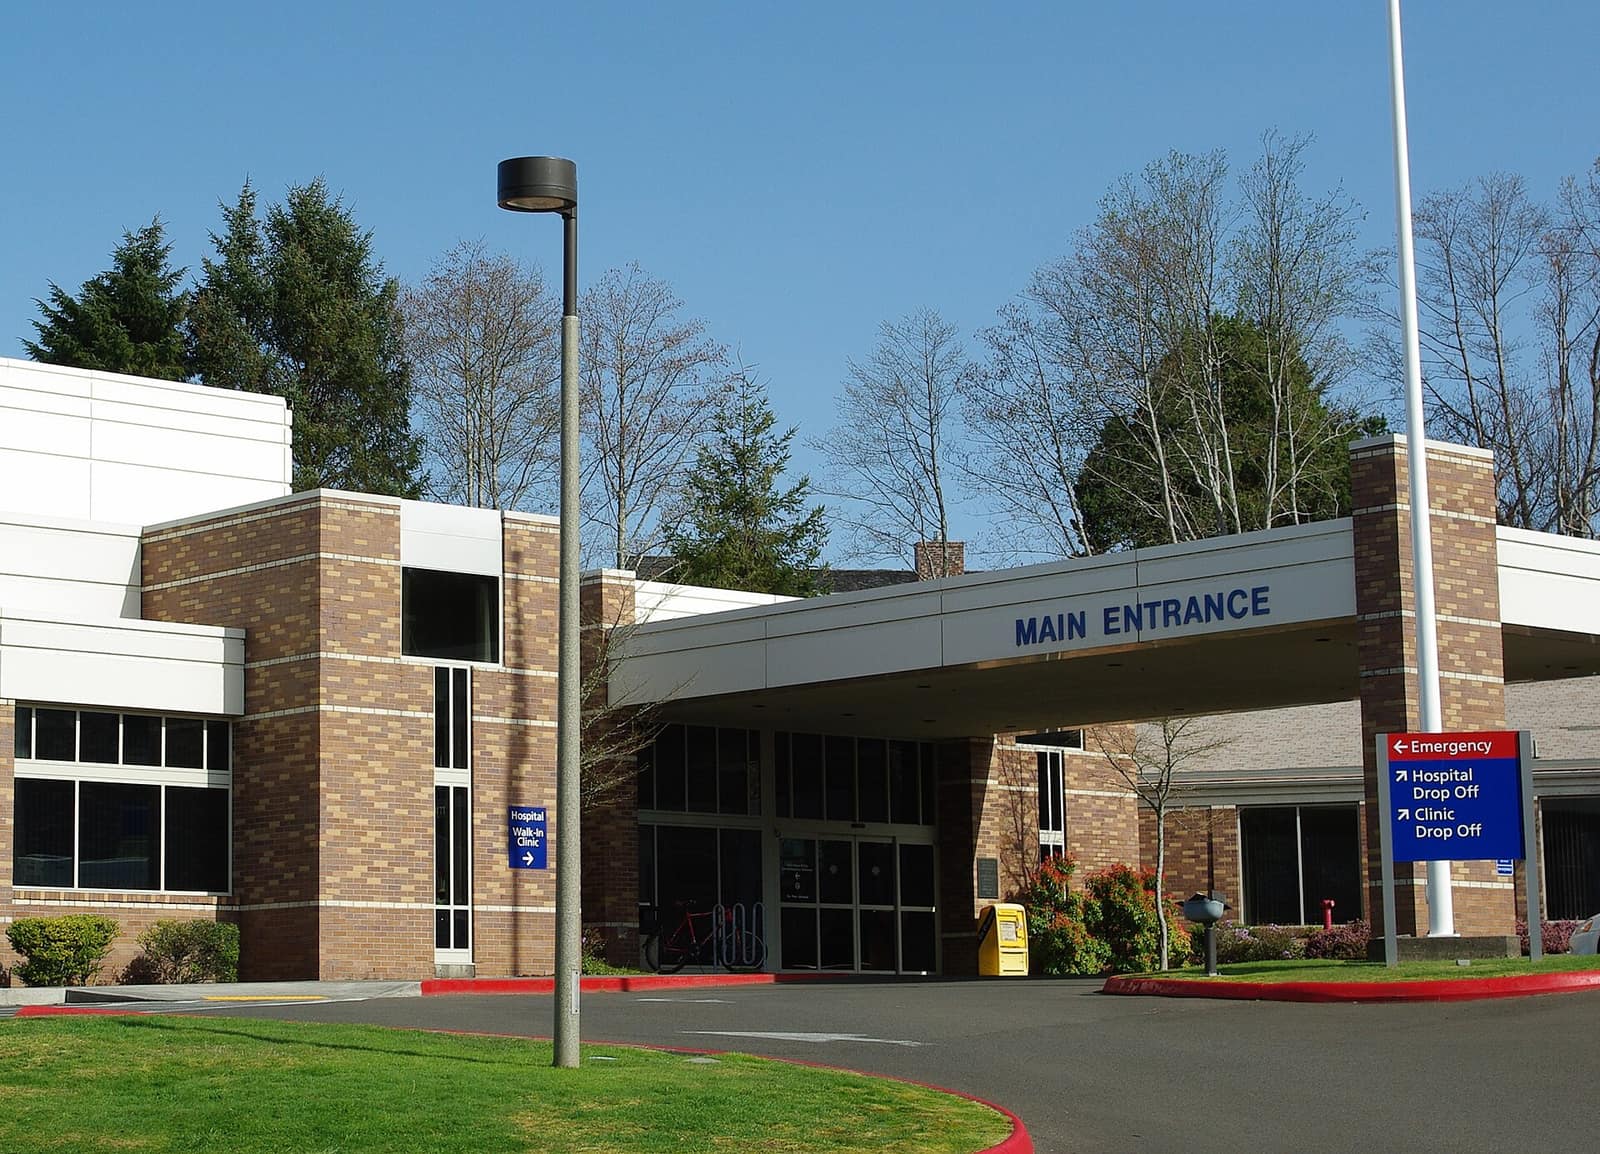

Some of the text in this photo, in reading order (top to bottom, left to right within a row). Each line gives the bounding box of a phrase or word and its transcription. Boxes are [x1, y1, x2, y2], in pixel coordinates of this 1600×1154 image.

[1015, 586, 1270, 646] MAIN ENTRANCE
[1411, 740, 1492, 755] Emergency
[1413, 768, 1472, 784] Hospital
[1413, 785, 1479, 802] Drop Off
[511, 811, 544, 823] Hospital
[1415, 807, 1455, 821] Clinic
[512, 827, 544, 837] Walk-In
[1416, 824, 1482, 840] Drop Off
[517, 837, 539, 847] Clinic
